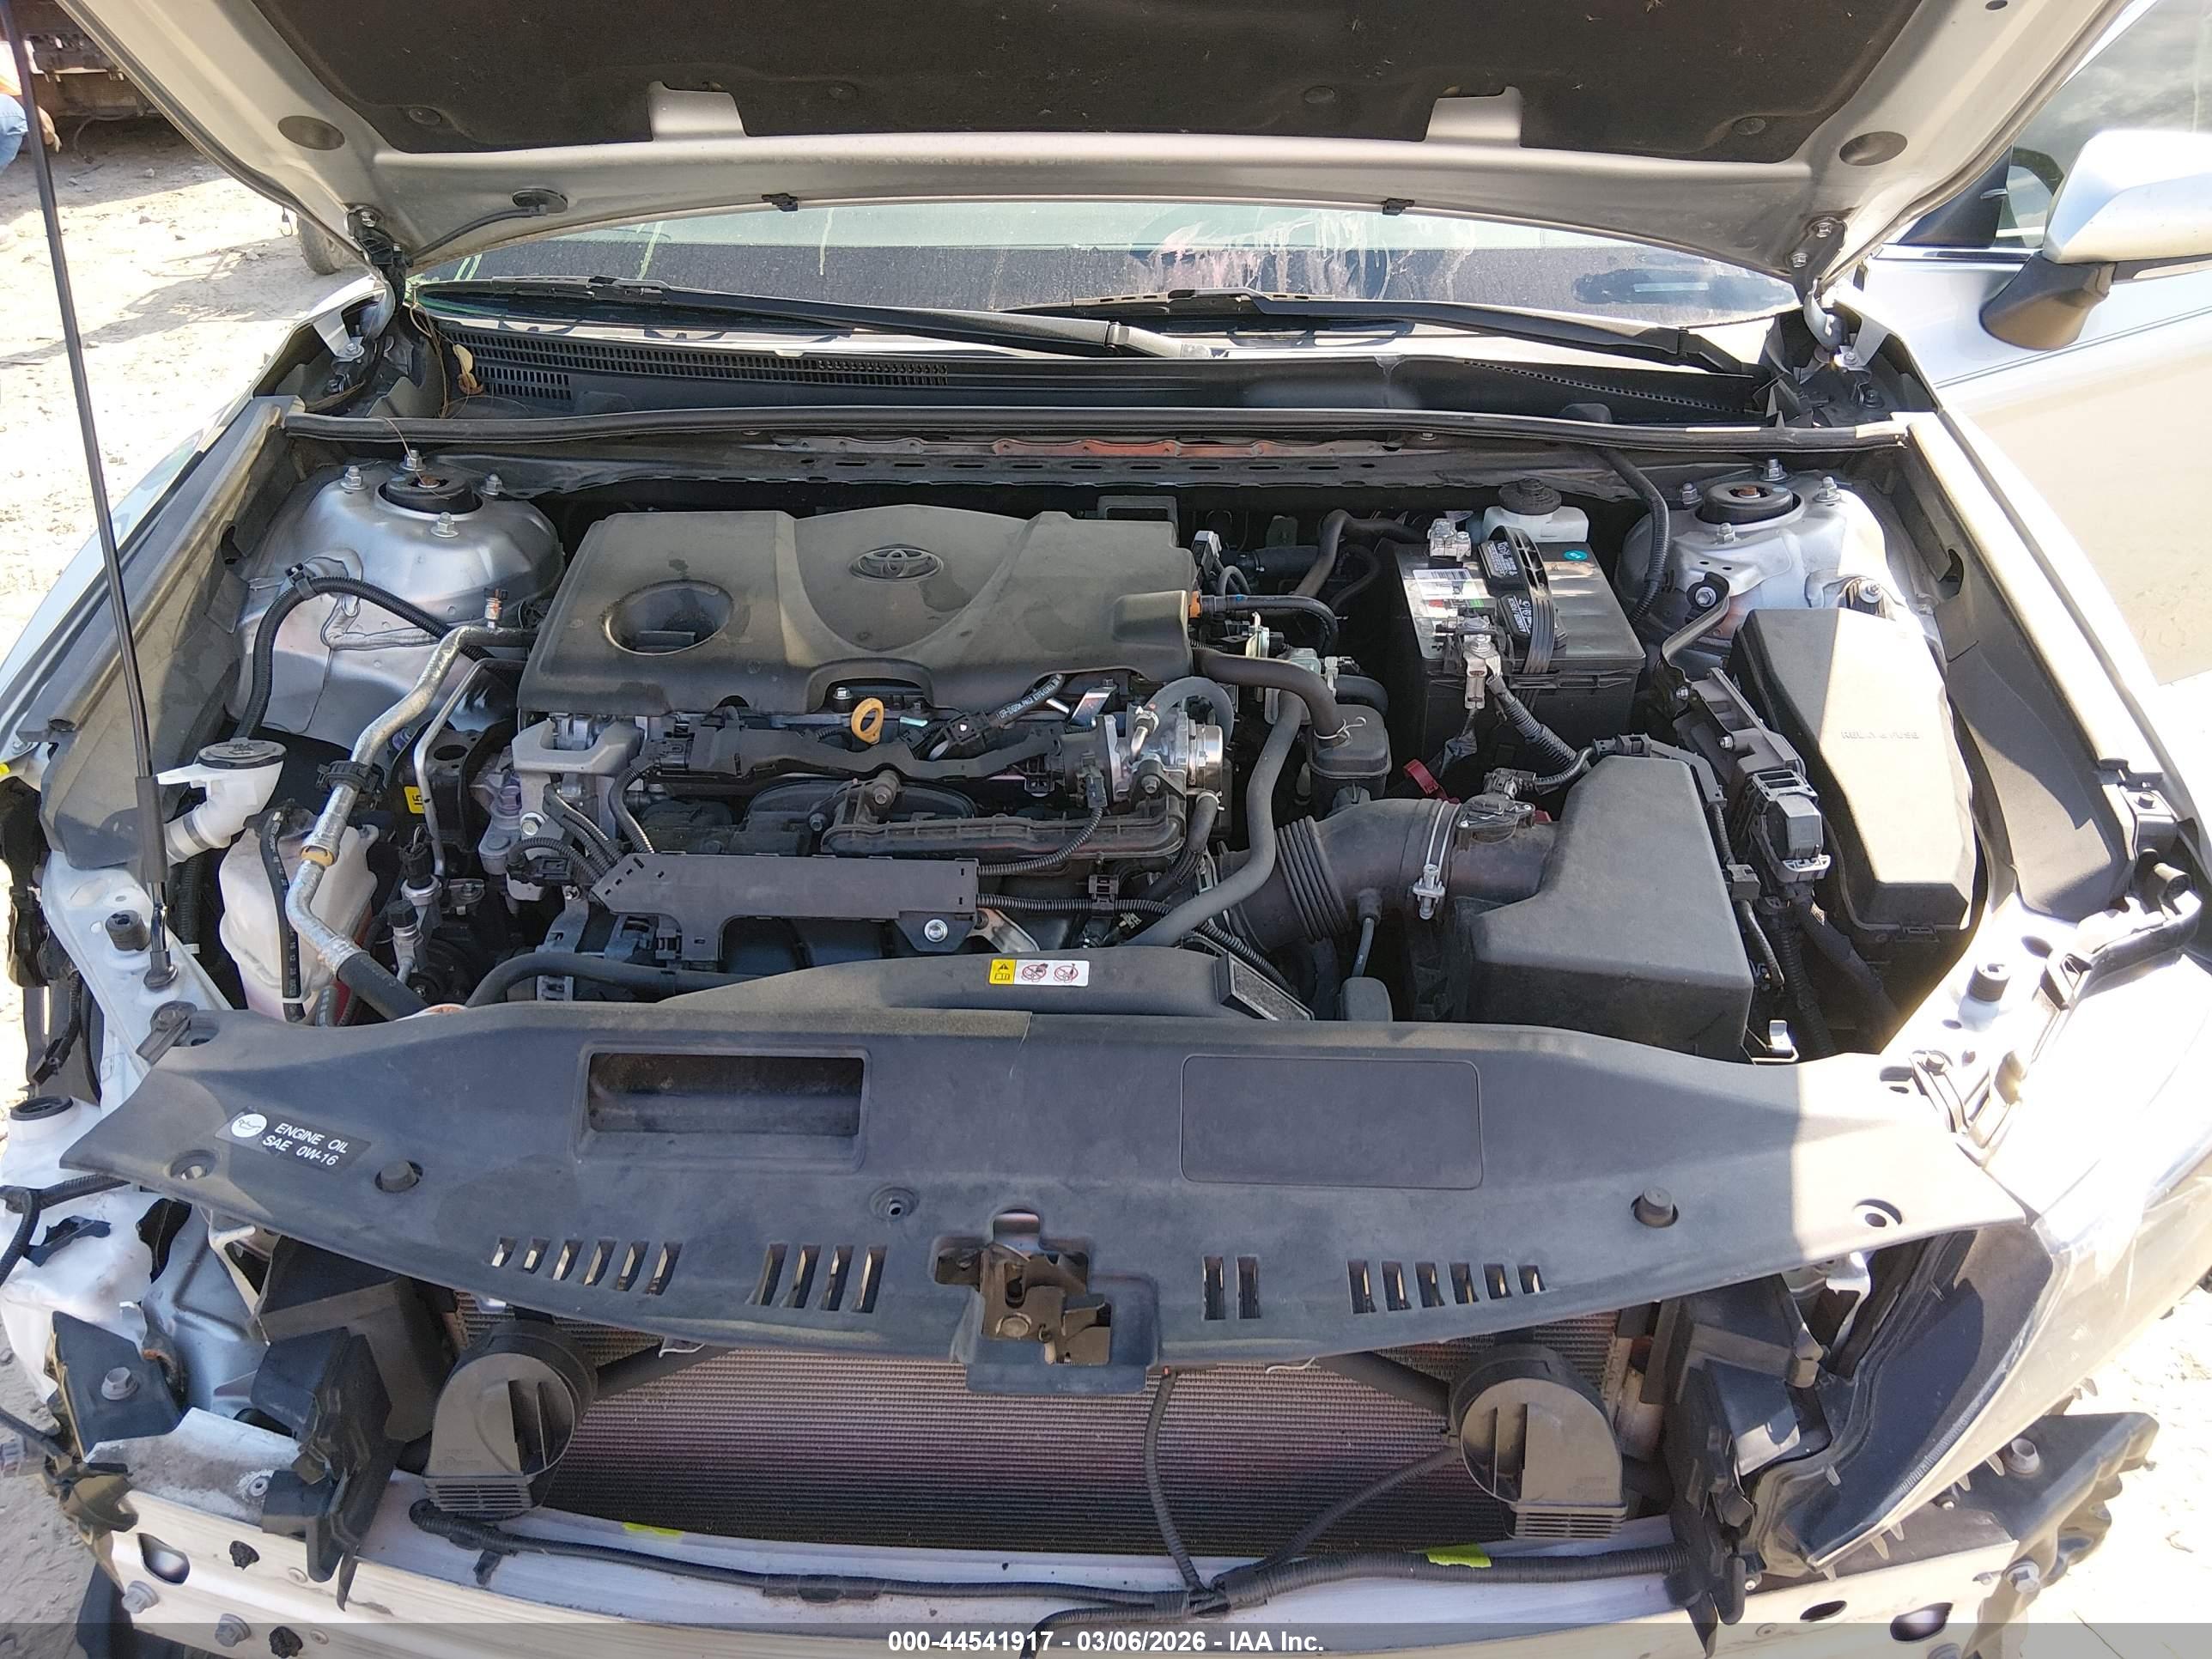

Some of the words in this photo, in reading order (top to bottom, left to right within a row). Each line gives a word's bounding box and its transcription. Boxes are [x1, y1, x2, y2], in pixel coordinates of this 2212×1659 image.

[262, 1134, 294, 1152] SAE
[295, 1146, 339, 1166] 0W-16
[275, 1122, 325, 1146] ENGINE
[327, 1139, 349, 1154] OIL
